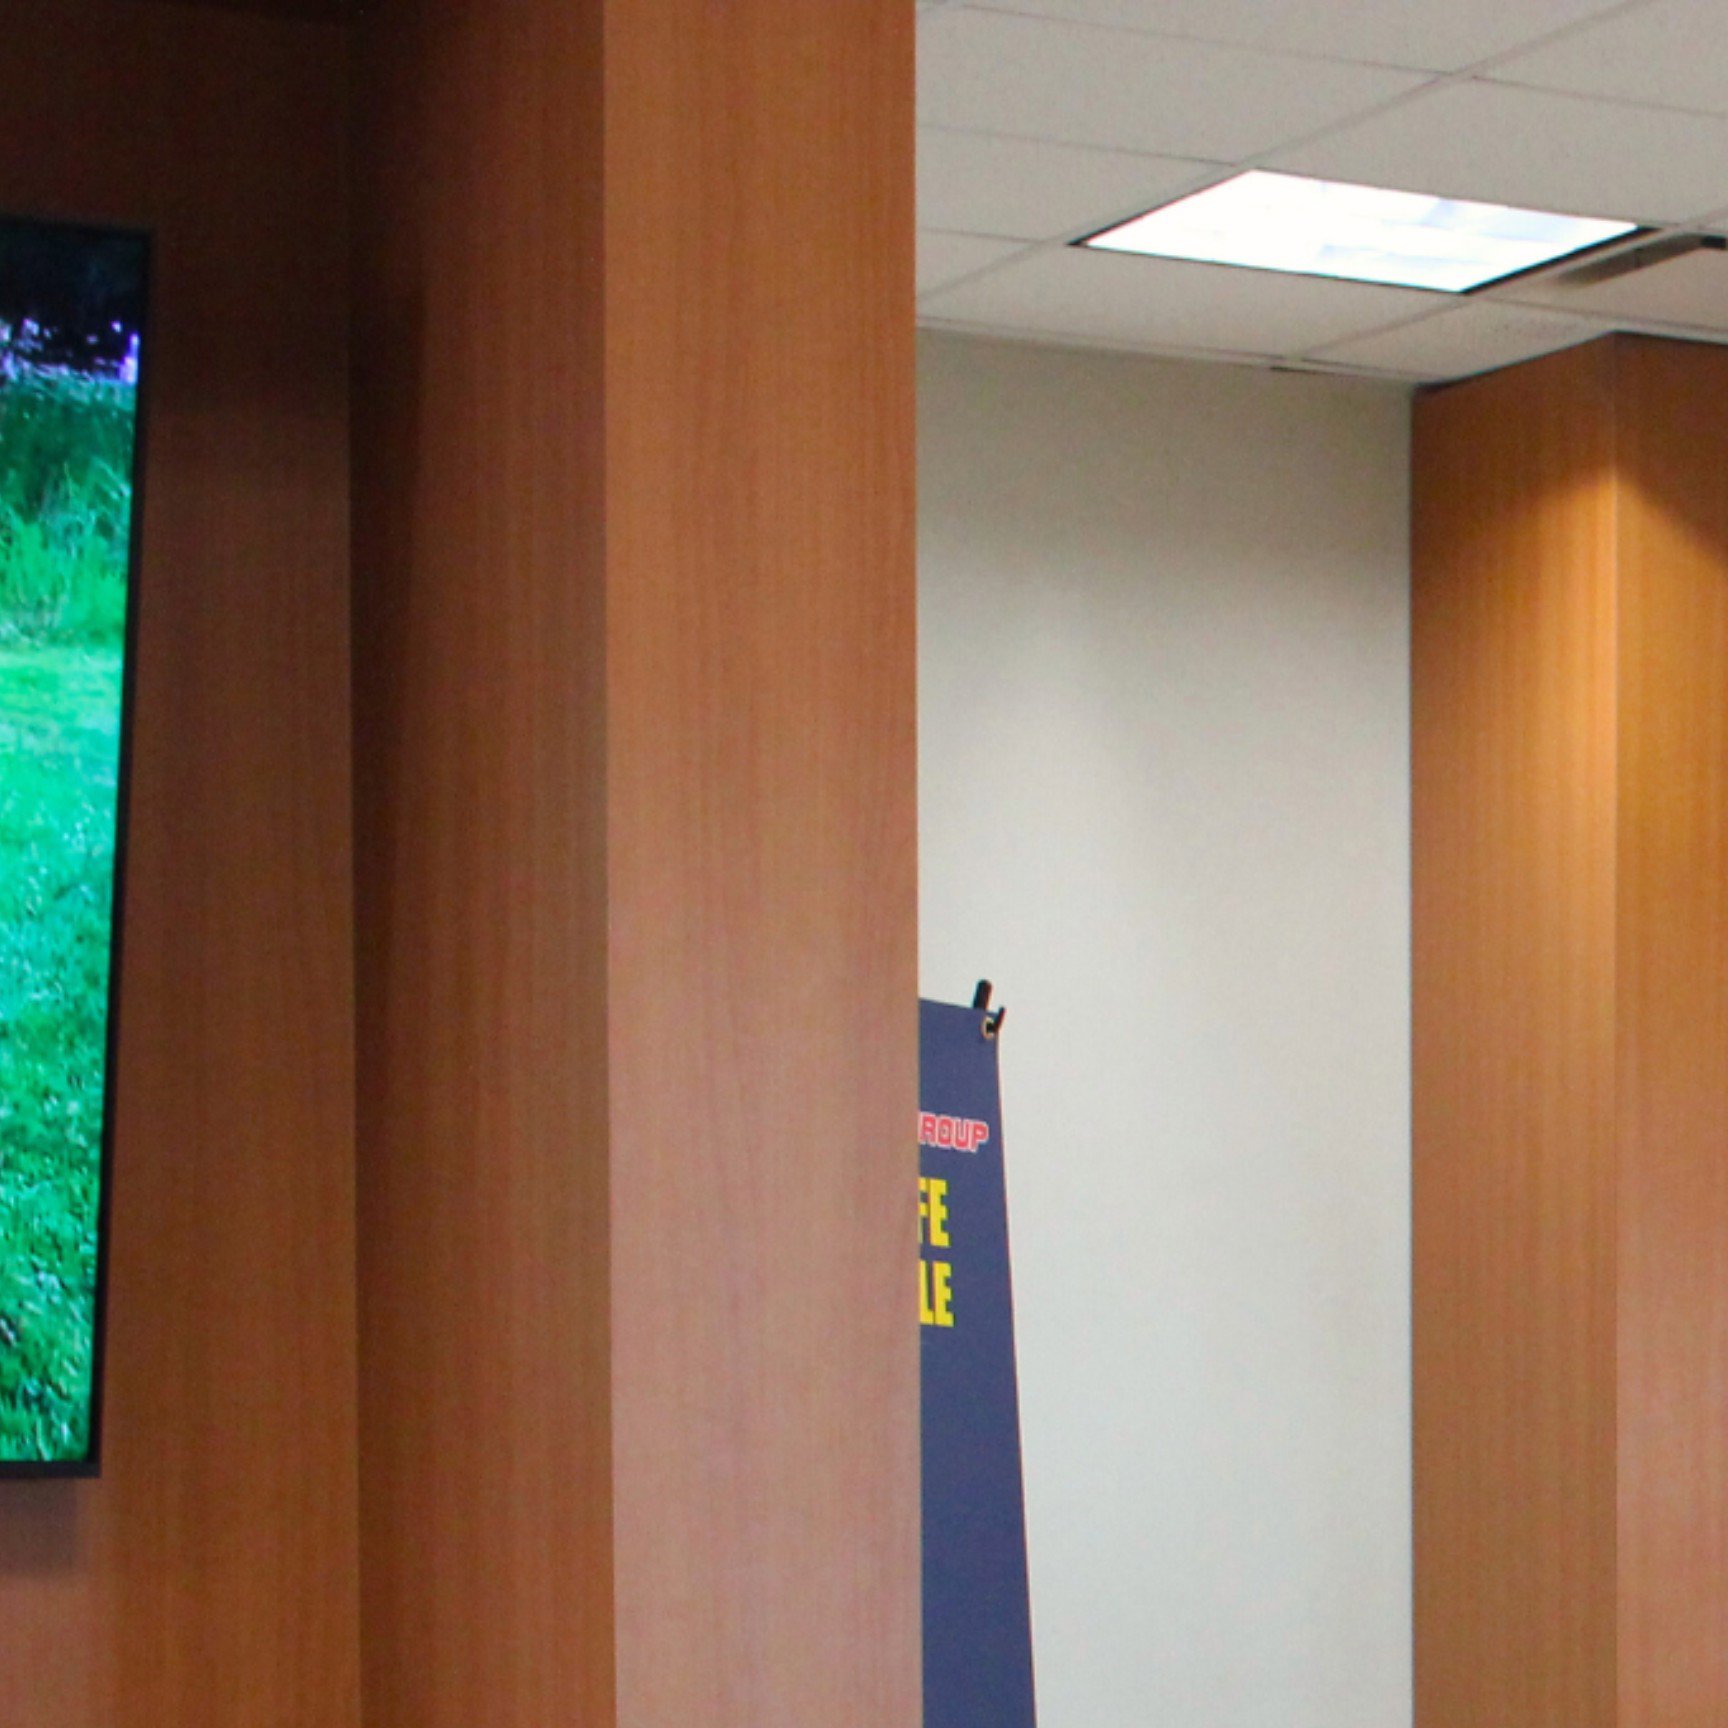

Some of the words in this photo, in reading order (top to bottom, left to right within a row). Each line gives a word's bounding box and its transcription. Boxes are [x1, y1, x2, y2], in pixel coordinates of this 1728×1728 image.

[919, 1111, 990, 1154] ROUP
[918, 1176, 950, 1247] FE
[919, 1260, 955, 1327] LE
